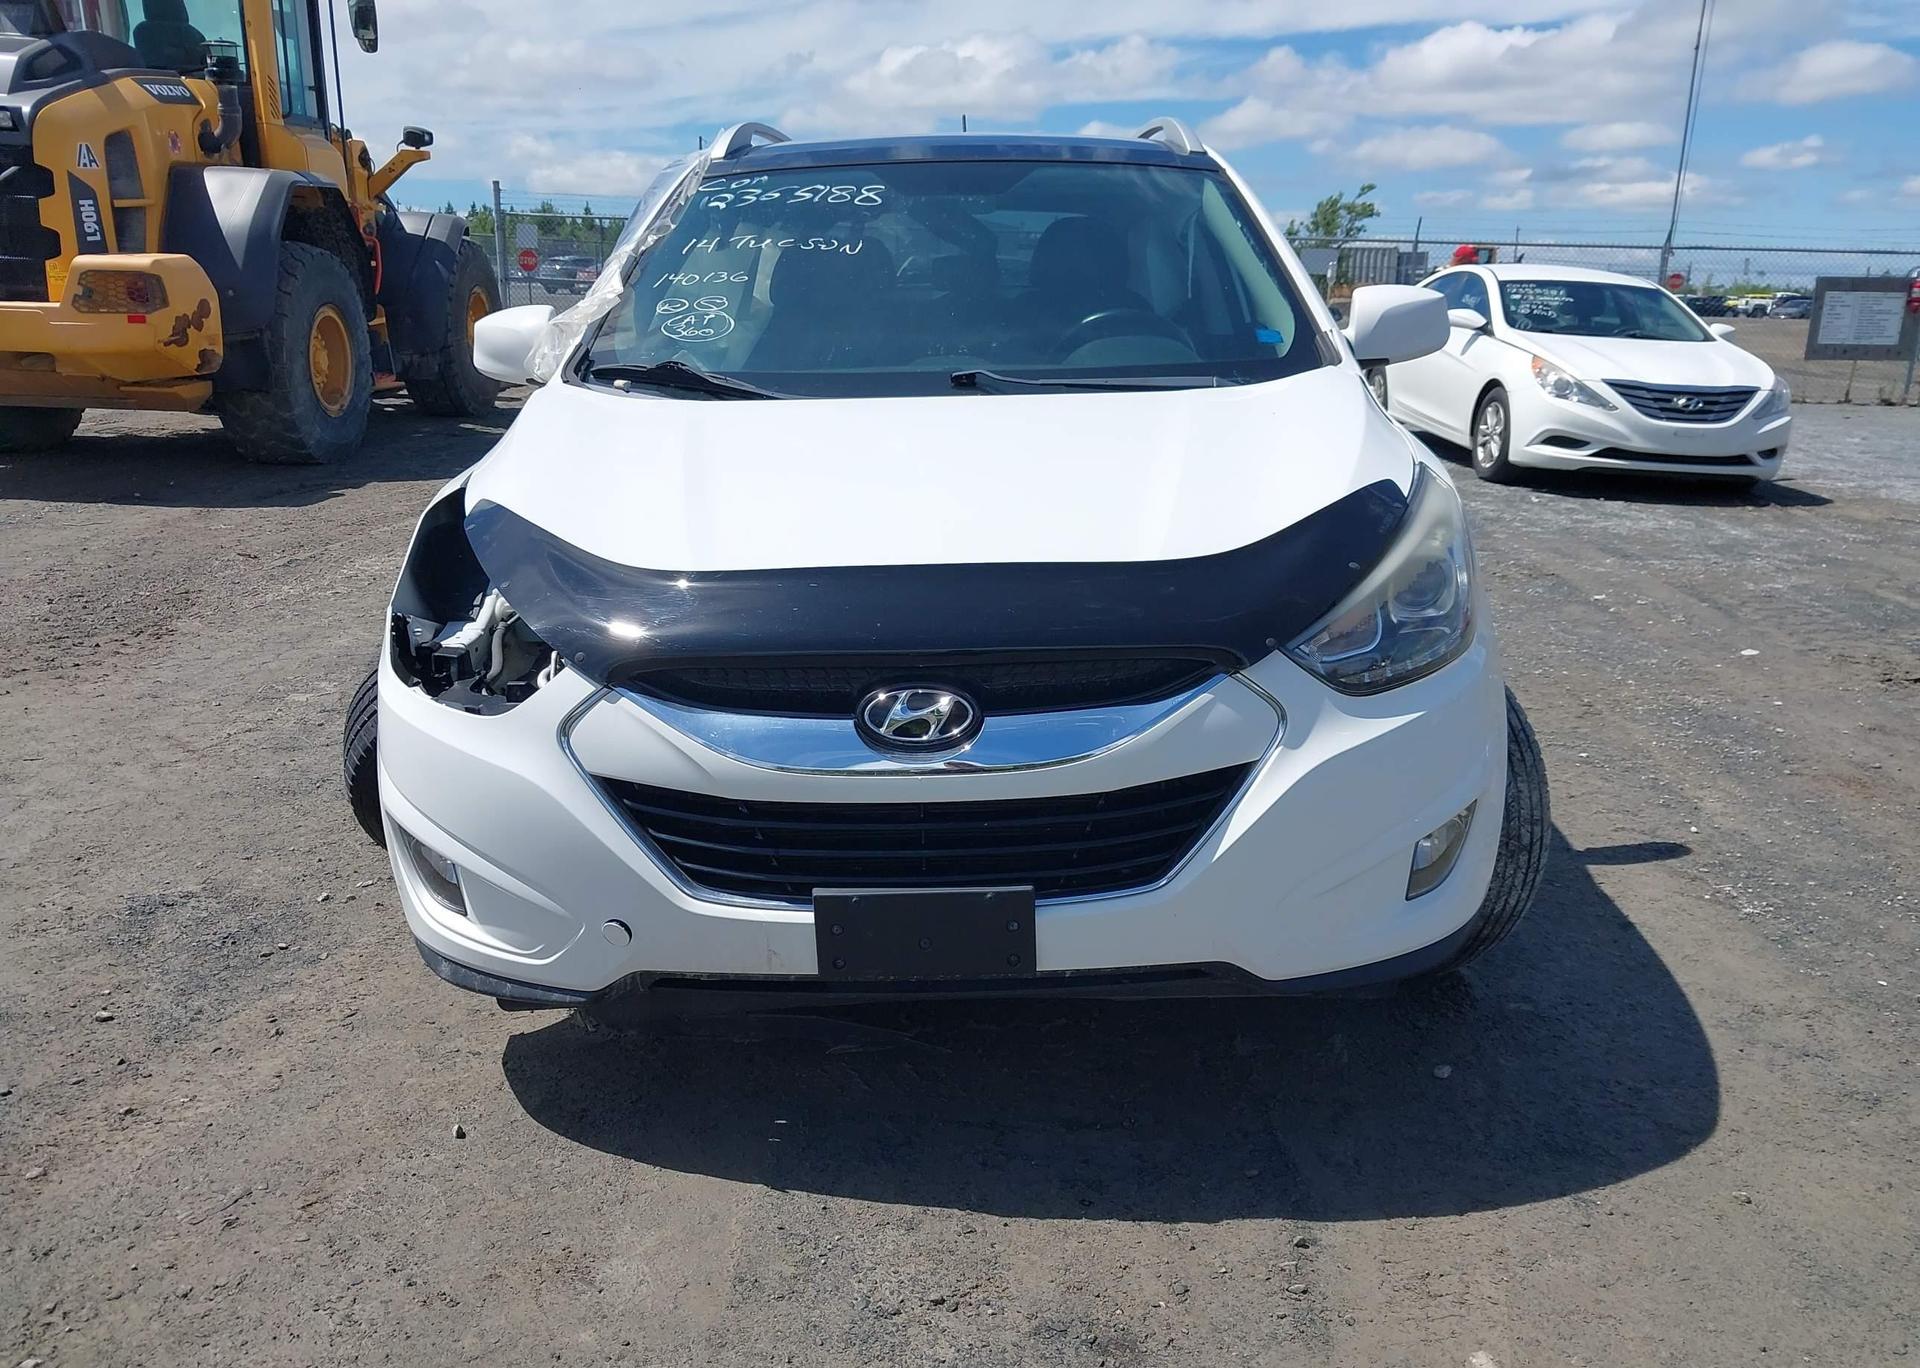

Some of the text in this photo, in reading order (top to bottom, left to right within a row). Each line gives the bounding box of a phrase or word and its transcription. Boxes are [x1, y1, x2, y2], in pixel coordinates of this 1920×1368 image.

[144, 84, 191, 97] VOLVO
[79, 199, 101, 241] L90H
[682, 235, 862, 254] 14 TUCSON
[653, 271, 748, 288] 140136
